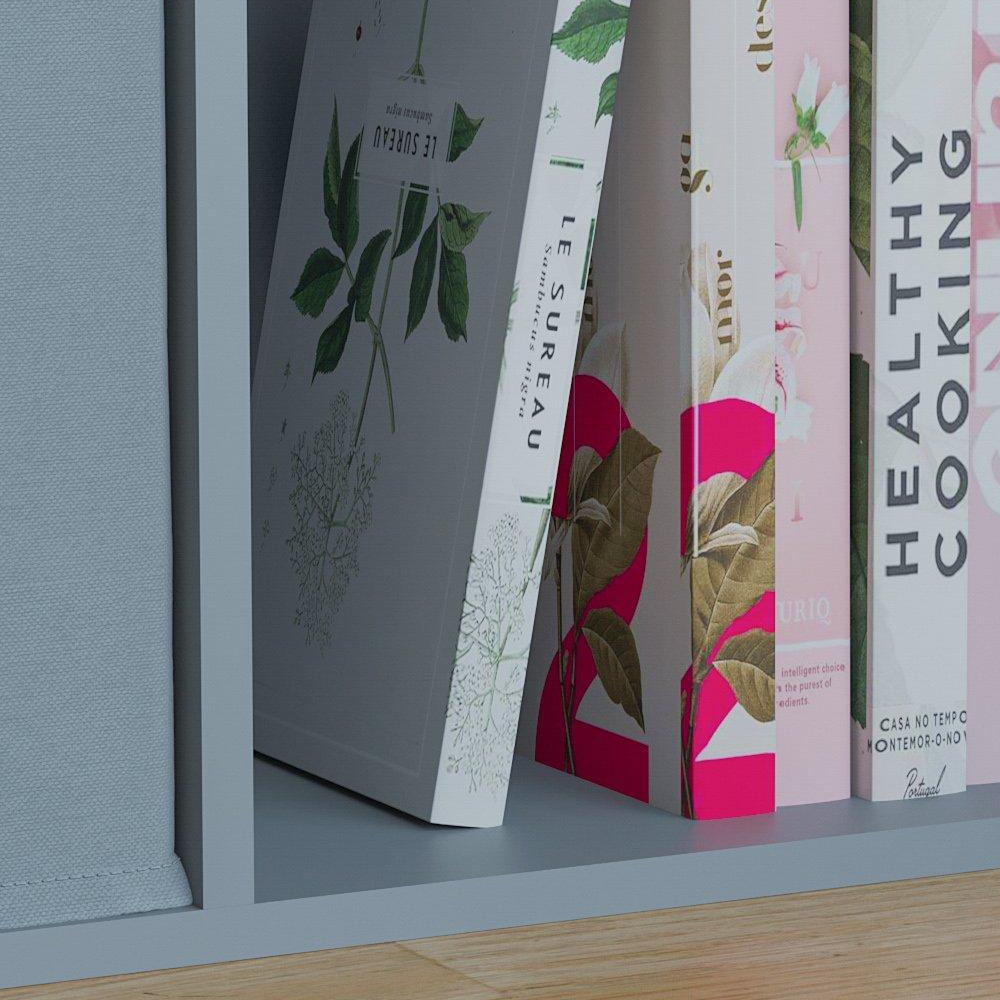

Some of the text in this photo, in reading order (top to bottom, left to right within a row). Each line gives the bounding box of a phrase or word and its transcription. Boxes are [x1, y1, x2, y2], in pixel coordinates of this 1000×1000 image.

[373, 125, 437, 159] LE SUREAU
[518, 243, 552, 419] Sambucus nigra
[526, 215, 576, 451] LE SUREAU
[884, 134, 923, 578] HEALTHY
[934, 128, 972, 578] COOKING
[781, 661, 846, 679] intelligent choice
[785, 682, 797, 693] the
[799, 680, 823, 694] purest
[824, 679, 832, 688] of
[879, 716, 911, 732] CASA
[915, 714, 929, 728] NO
[902, 764, 947, 800] Portugal
